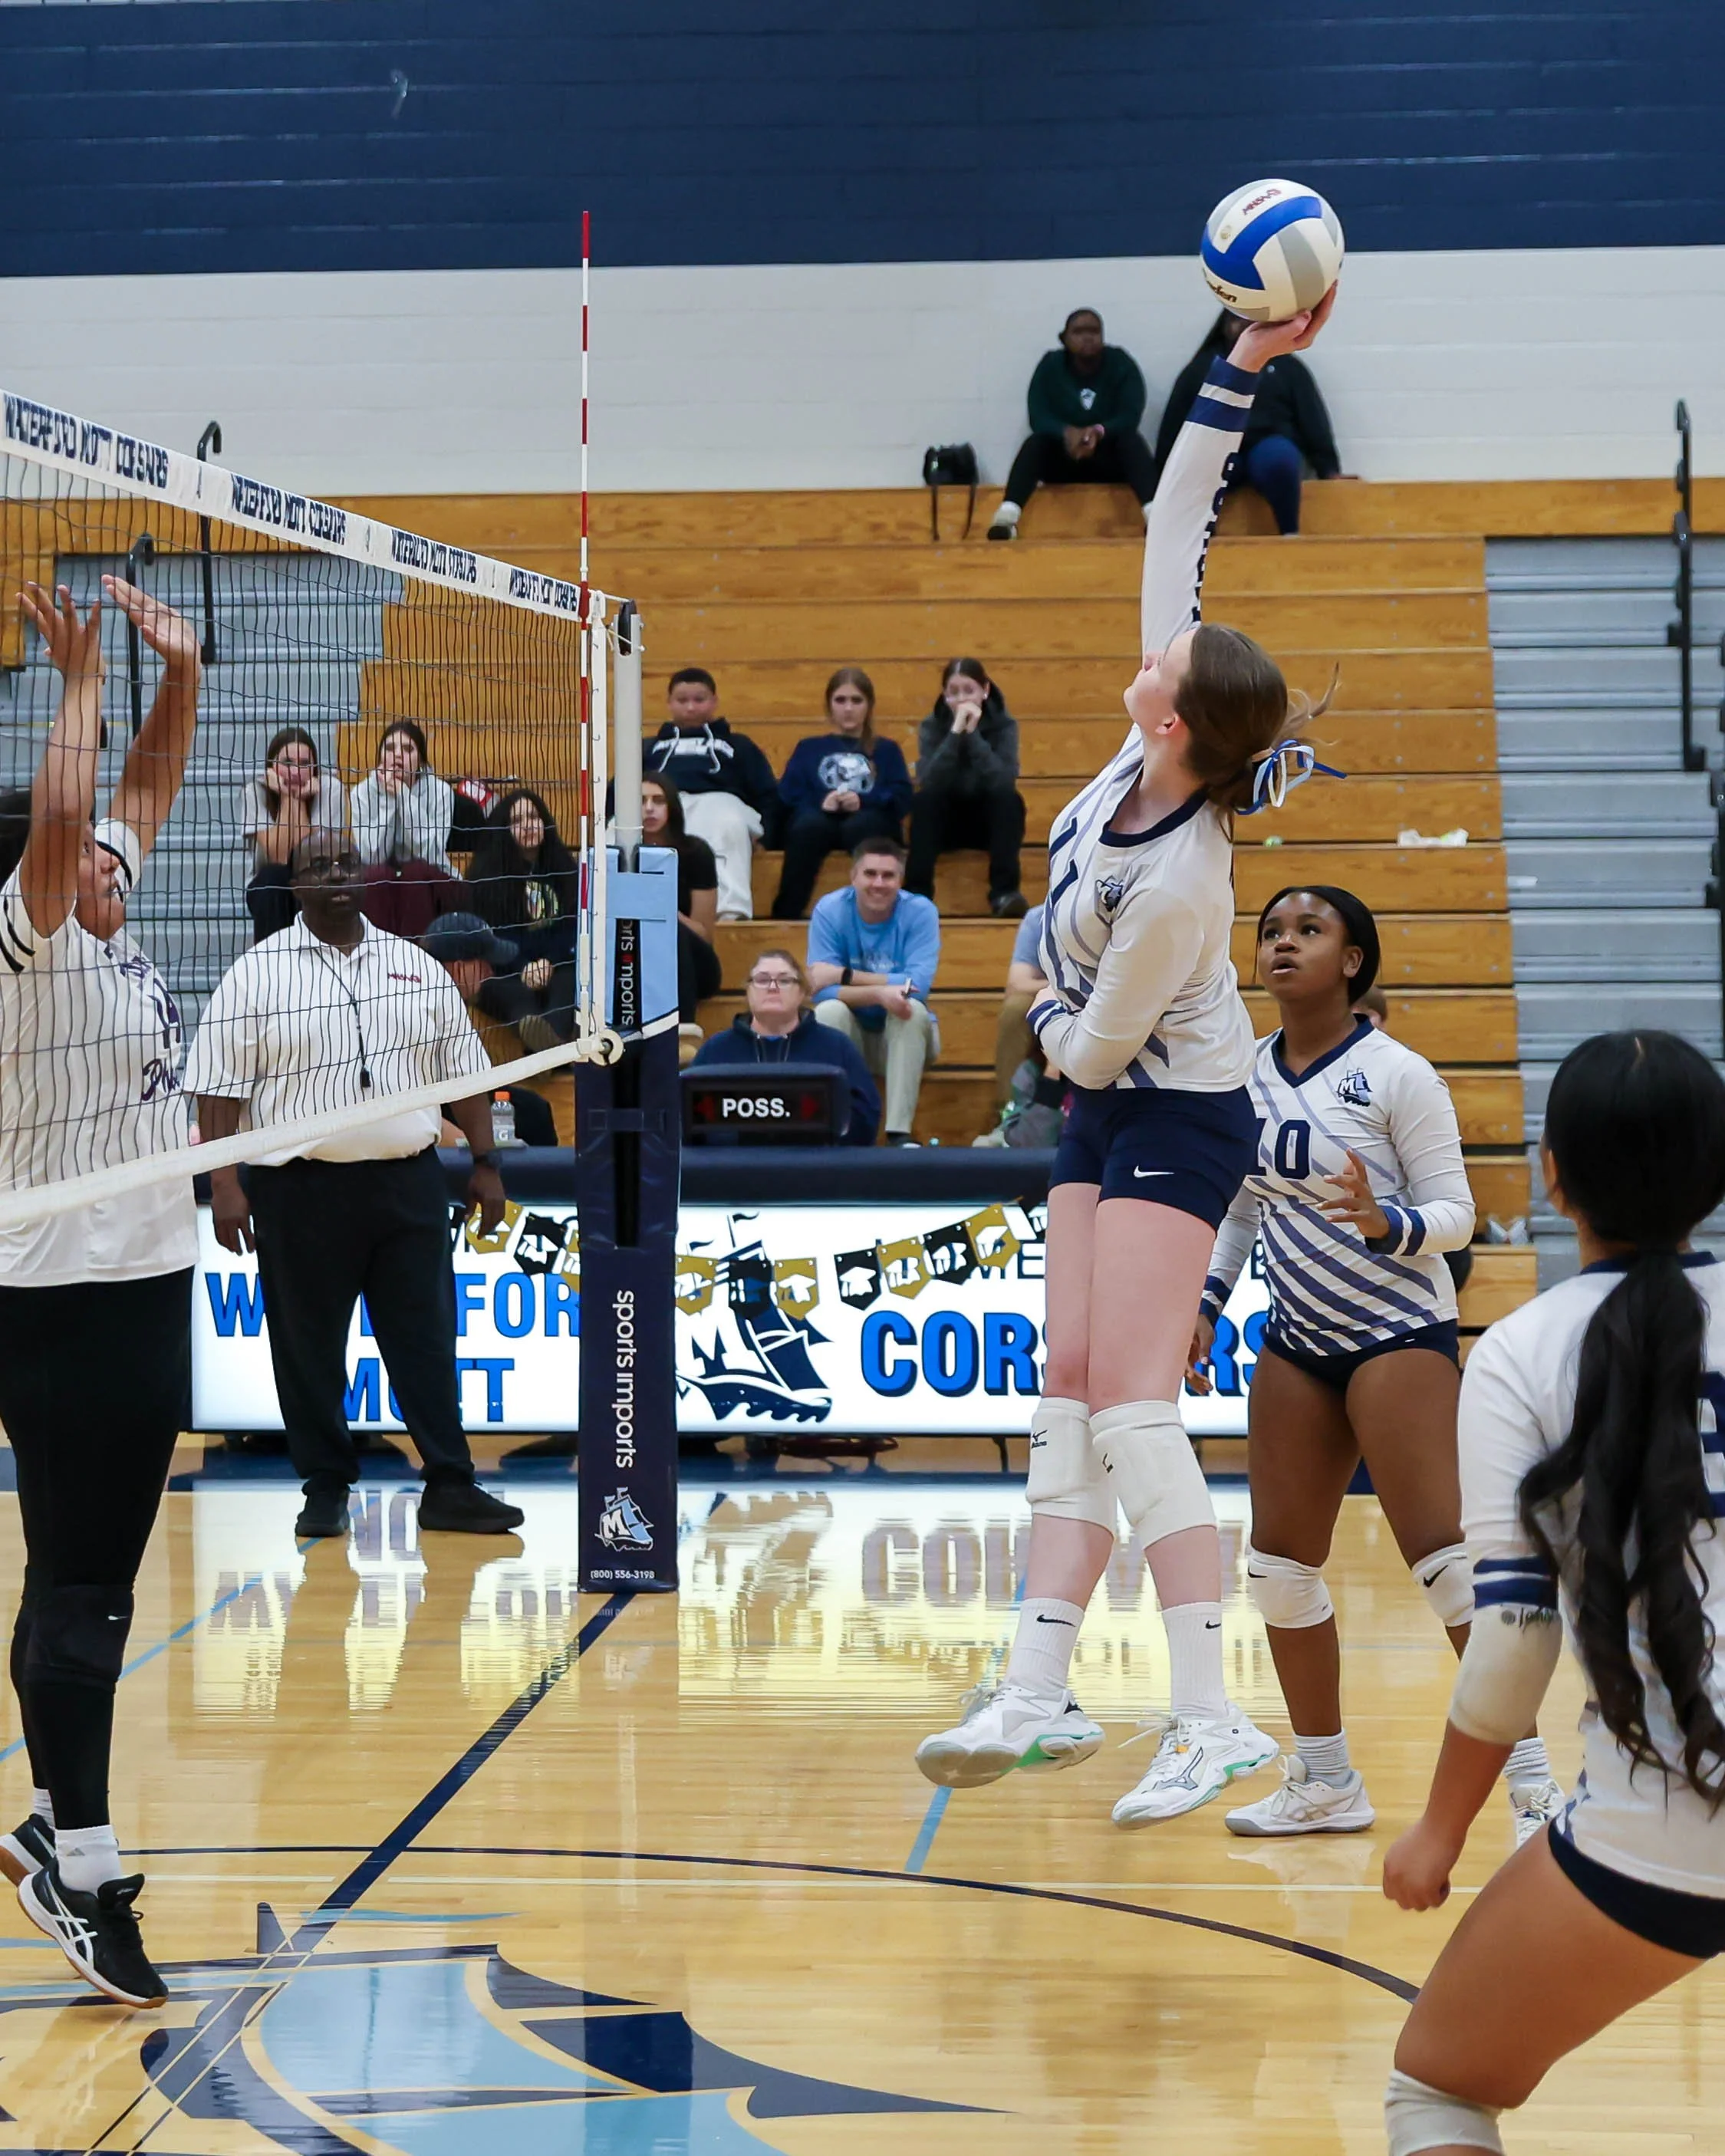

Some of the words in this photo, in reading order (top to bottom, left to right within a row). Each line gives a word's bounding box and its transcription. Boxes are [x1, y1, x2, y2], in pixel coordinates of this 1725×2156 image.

[621, 920, 635, 951] orts
[722, 1098, 791, 1117] POSS.
[613, 1289, 635, 1368] sports
[613, 1372, 637, 1469] imports
[590, 1569, 613, 1580] (800)
